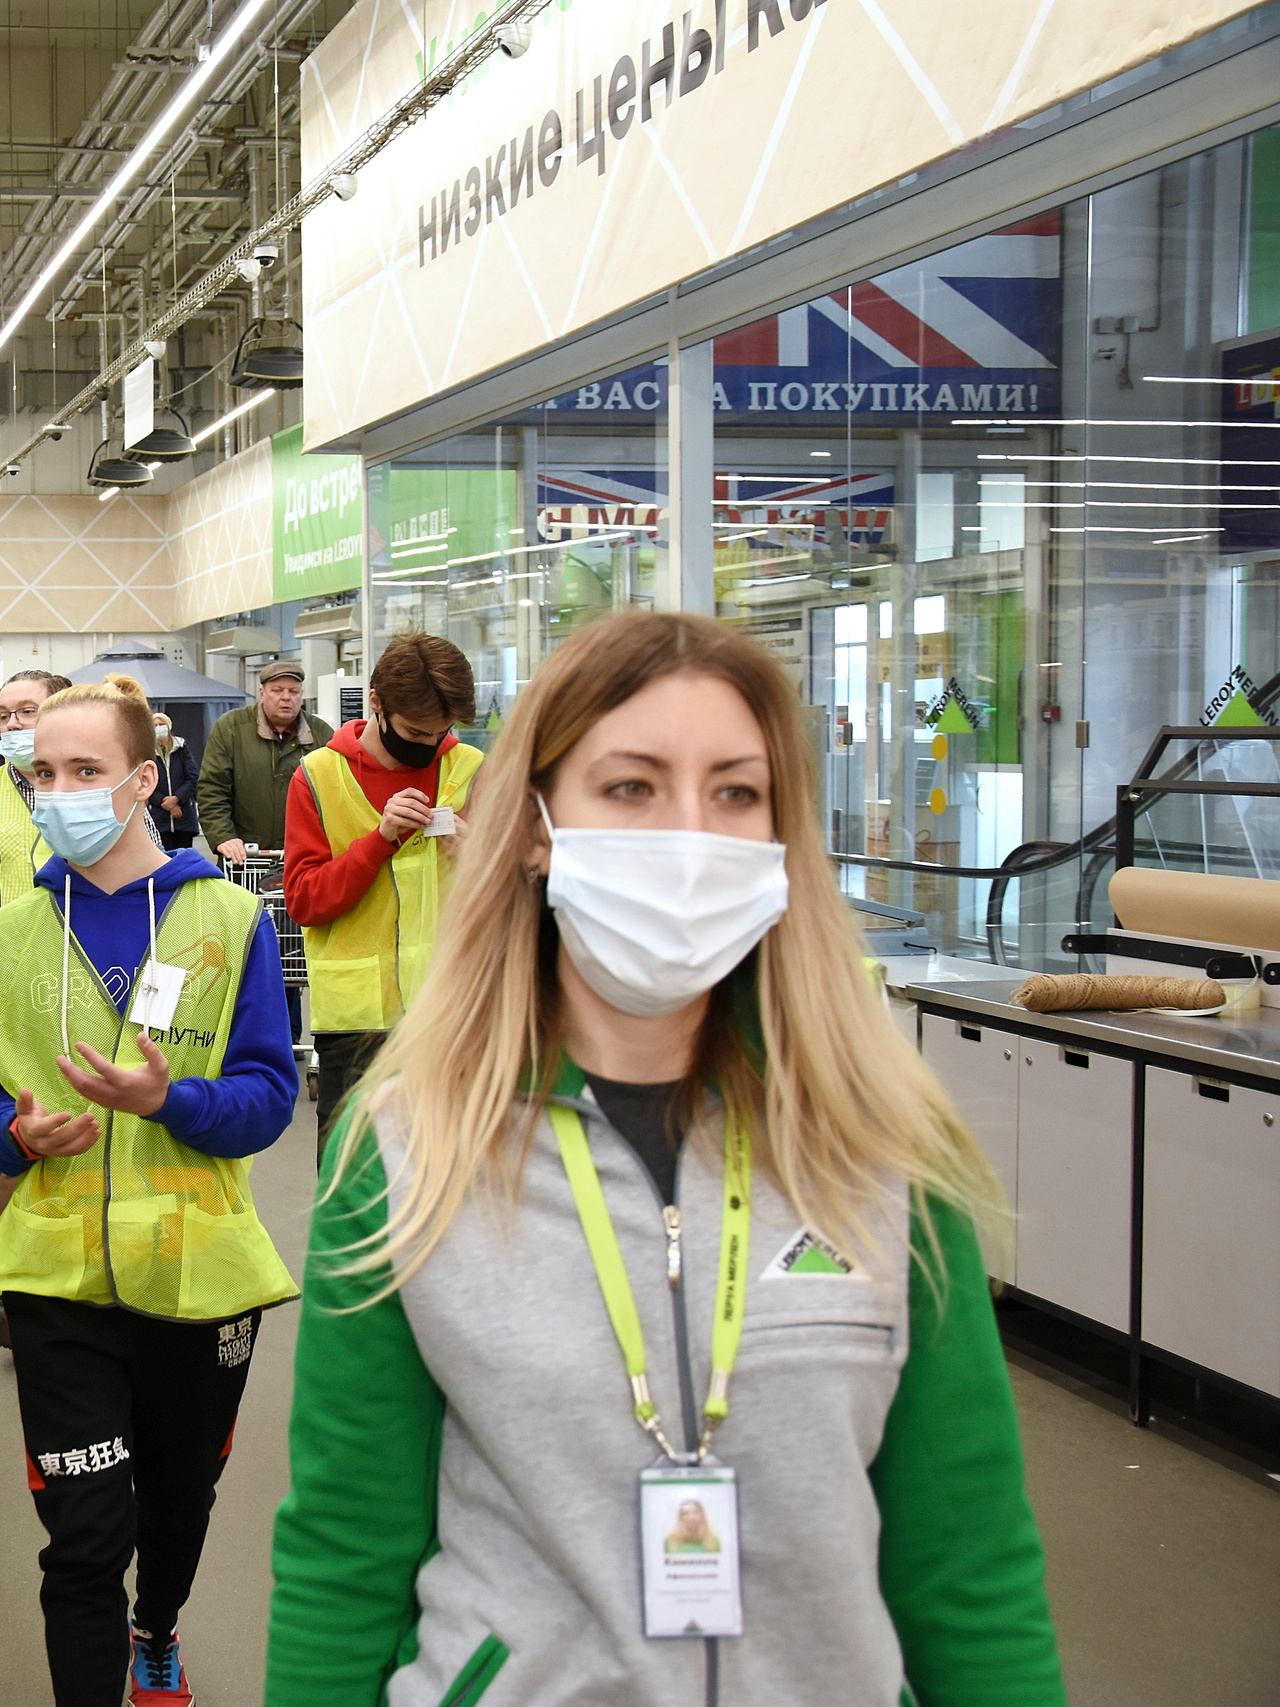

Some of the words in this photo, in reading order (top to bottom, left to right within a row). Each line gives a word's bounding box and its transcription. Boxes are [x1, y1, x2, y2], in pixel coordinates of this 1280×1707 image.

[418, 109, 563, 268] низкие
[575, 0, 725, 176] цены
[575, 381, 661, 411] ВАС
[713, 381, 733, 410] А
[748, 381, 1039, 412] ПОКУПКАМИ!
[283, 477, 308, 534] До
[309, 460, 362, 519] встре
[284, 549, 322, 576] Увидимся
[323, 547, 333, 565] на
[1198, 676, 1236, 727] LEROY
[1231, 664, 1280, 727] MEIN
[30, 966, 201, 1013] CRO
[148, 1026, 217, 1048] СПУТНИ
[218, 1316, 253, 1345] 東京
[38, 1435, 130, 1477] 東京狂気
